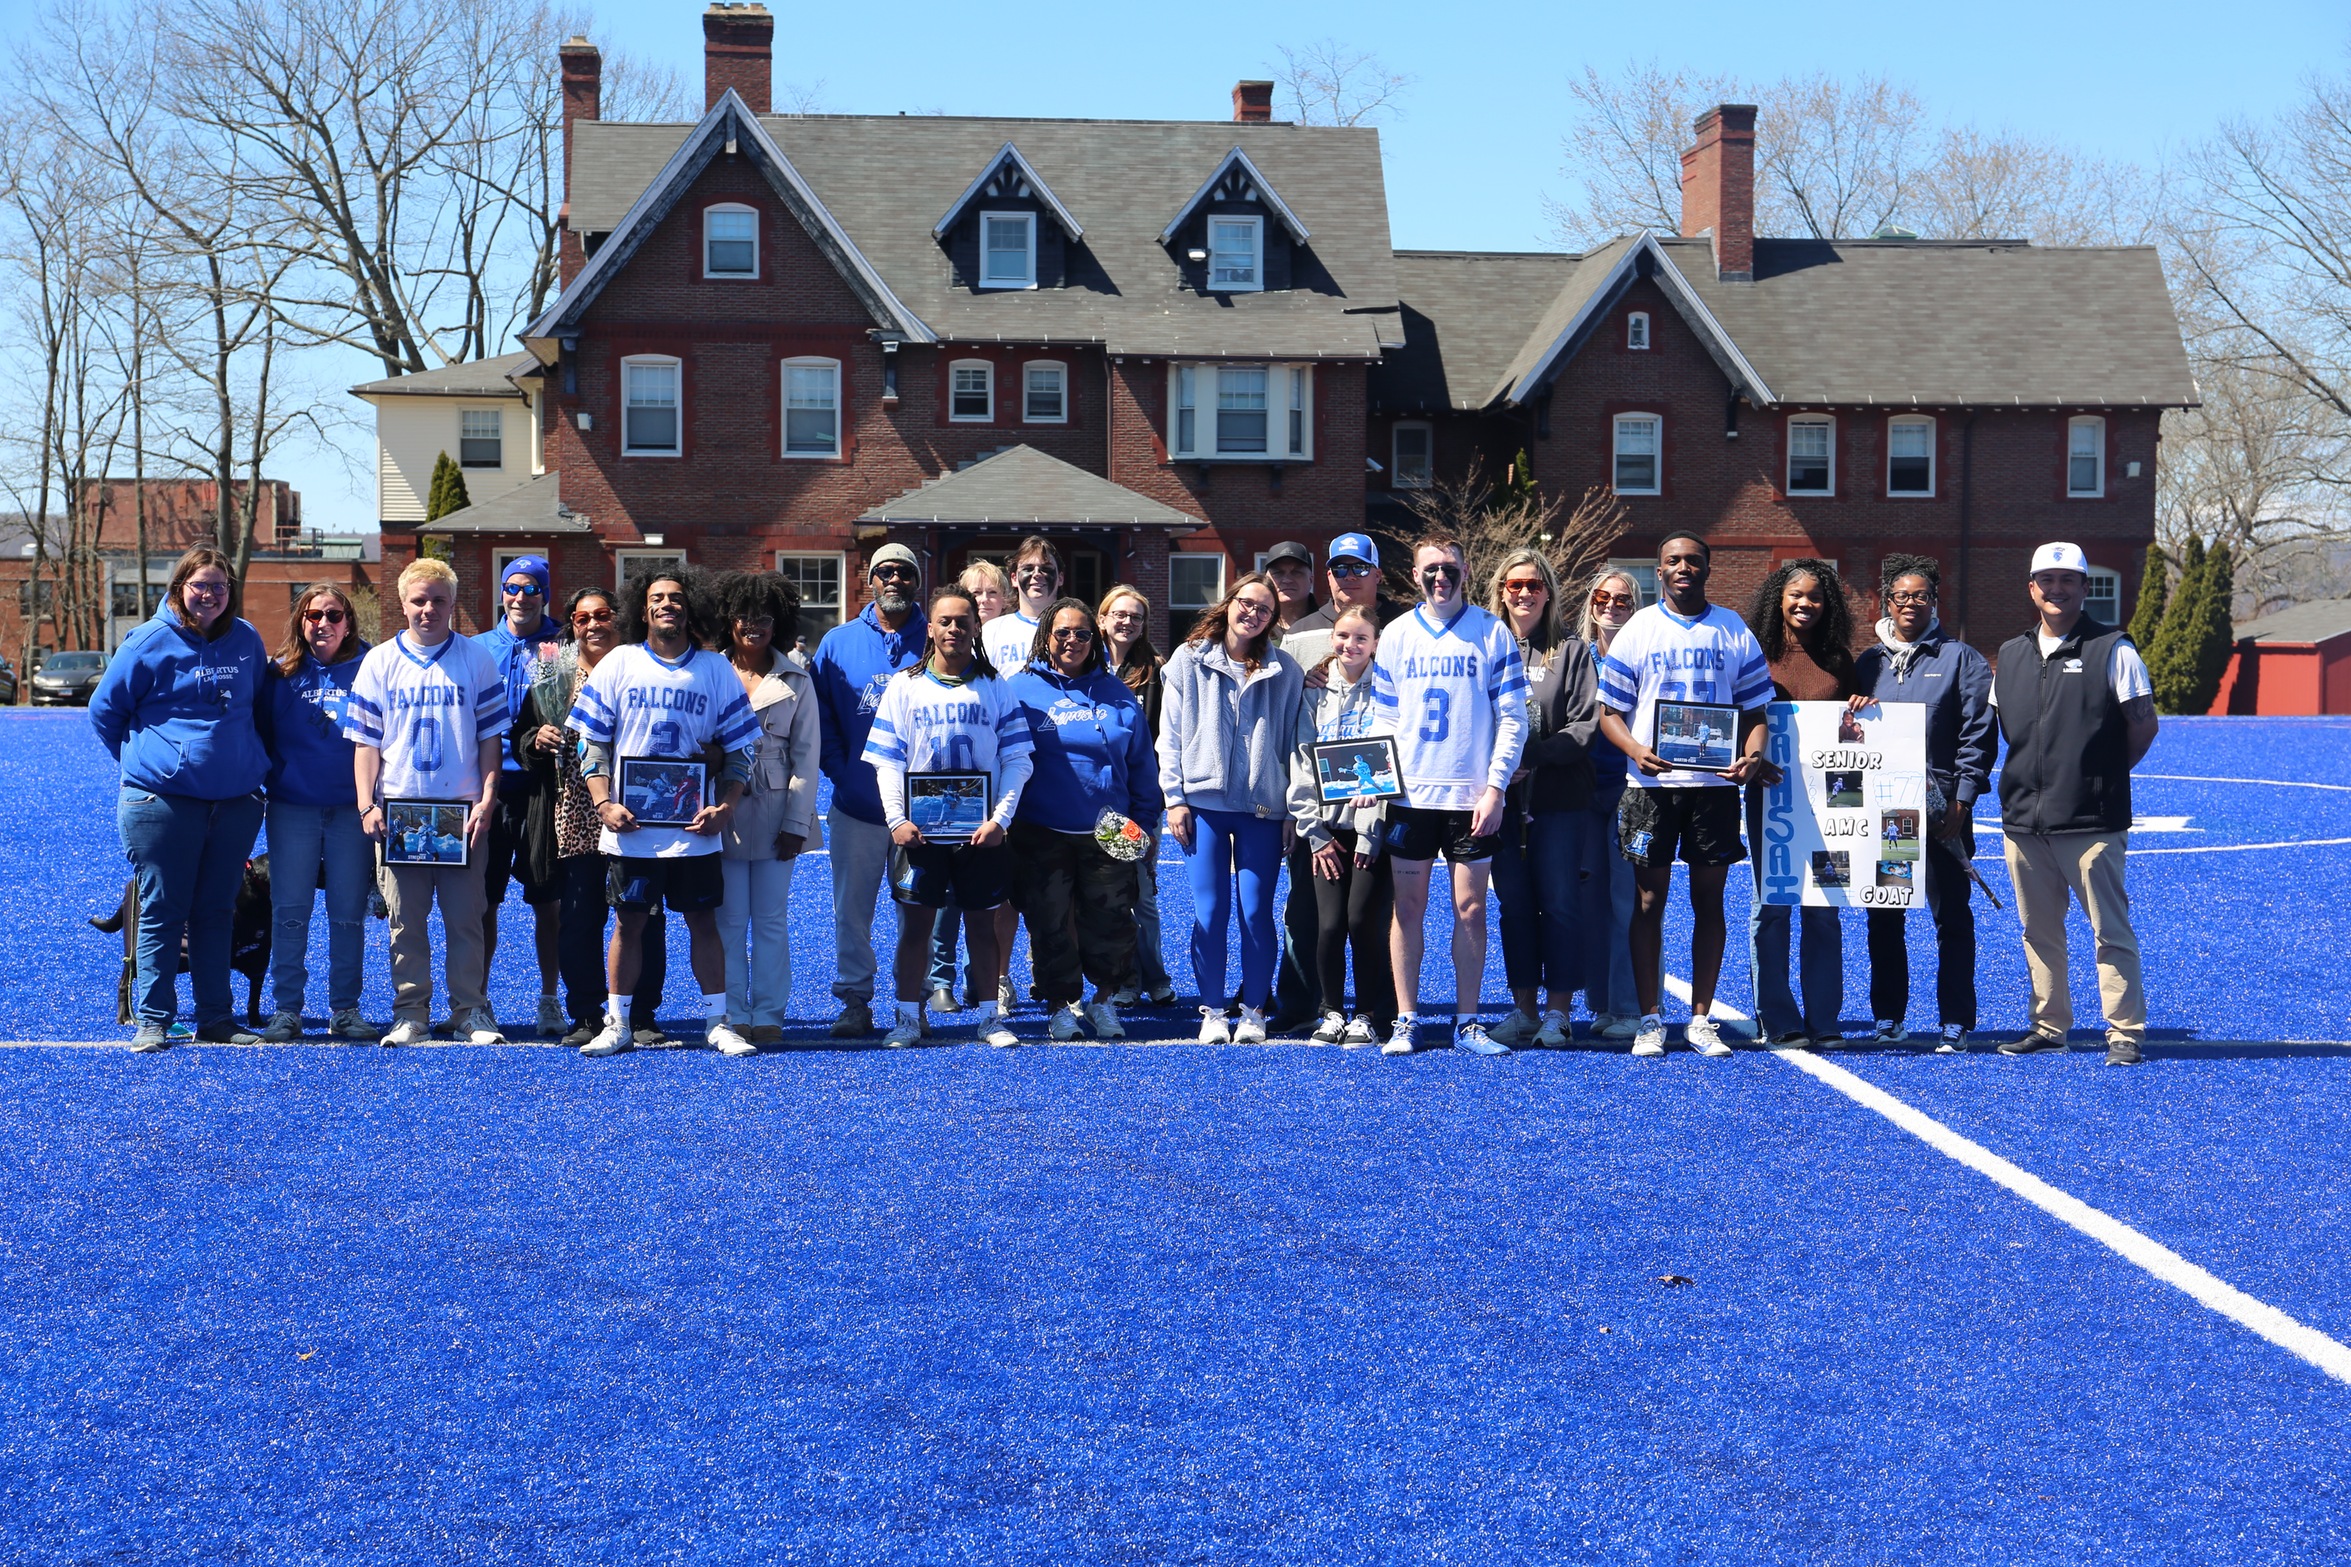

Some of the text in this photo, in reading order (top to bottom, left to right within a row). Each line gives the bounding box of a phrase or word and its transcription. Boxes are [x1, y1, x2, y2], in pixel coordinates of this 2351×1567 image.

[1000, 642, 1027, 664] FAL
[1404, 655, 1477, 678] ALCONS
[387, 685, 465, 710] FALCONS
[628, 686, 708, 716] FALCONS
[913, 702, 990, 729] FALCONS
[1418, 687, 1451, 743] 3
[411, 716, 443, 773] 0
[649, 720, 682, 757] 2
[929, 734, 976, 773] 10
[1811, 750, 1882, 770] SENIOR
[1875, 776, 1925, 804] #77
[1824, 818, 1868, 837] AMC
[1860, 885, 1914, 905] GOAT
